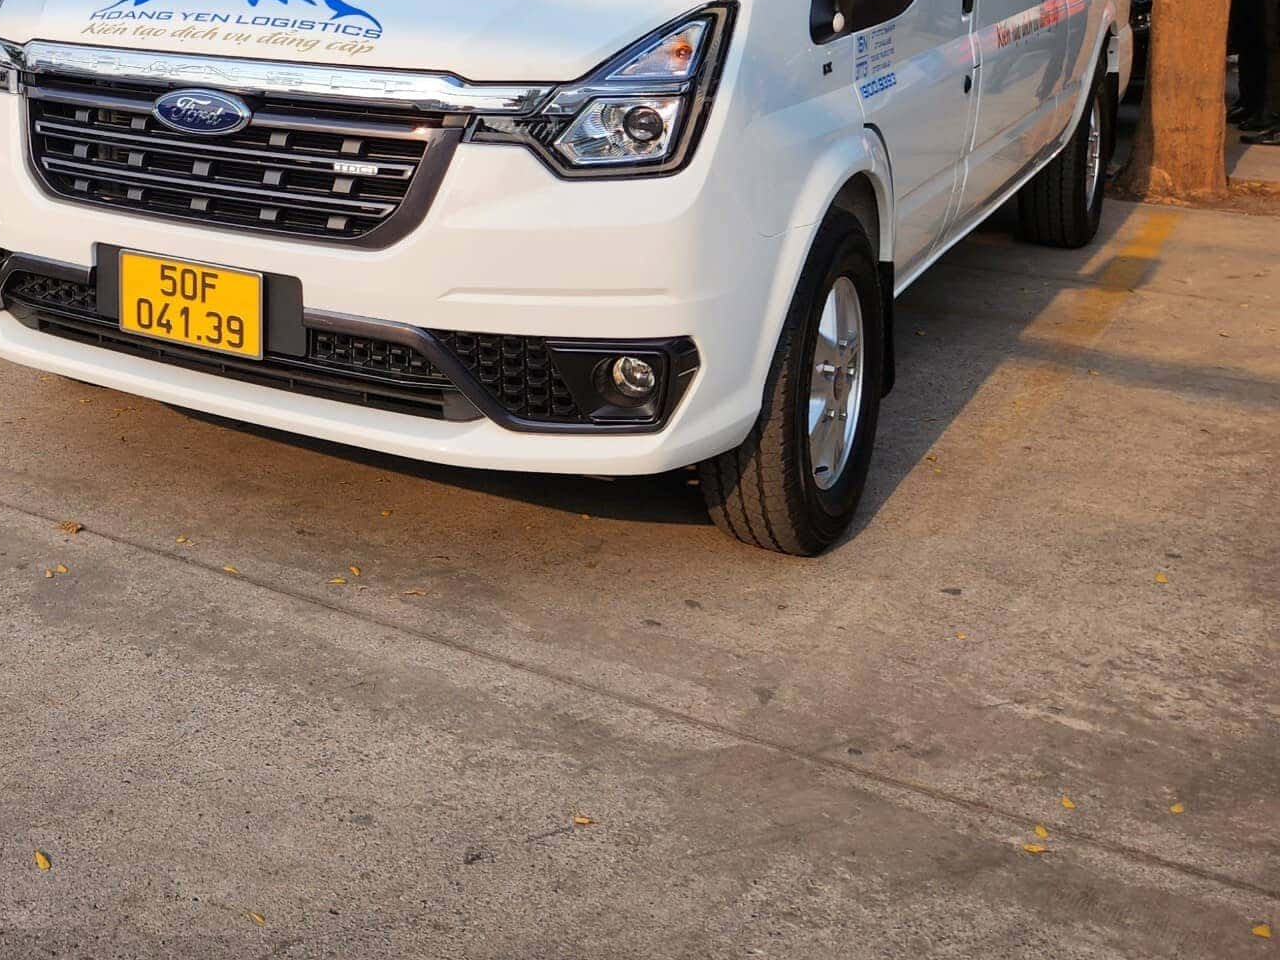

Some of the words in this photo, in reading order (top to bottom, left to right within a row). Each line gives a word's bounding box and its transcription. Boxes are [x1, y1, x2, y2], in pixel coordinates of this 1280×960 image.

[88, 10, 174, 21] HOANG
[181, 12, 231, 23] YEN
[236, 15, 382, 39] LOGISTICS
[173, 96, 225, 127] Ford
[160, 264, 218, 303] 50F
[137, 297, 244, 349] 041.39
